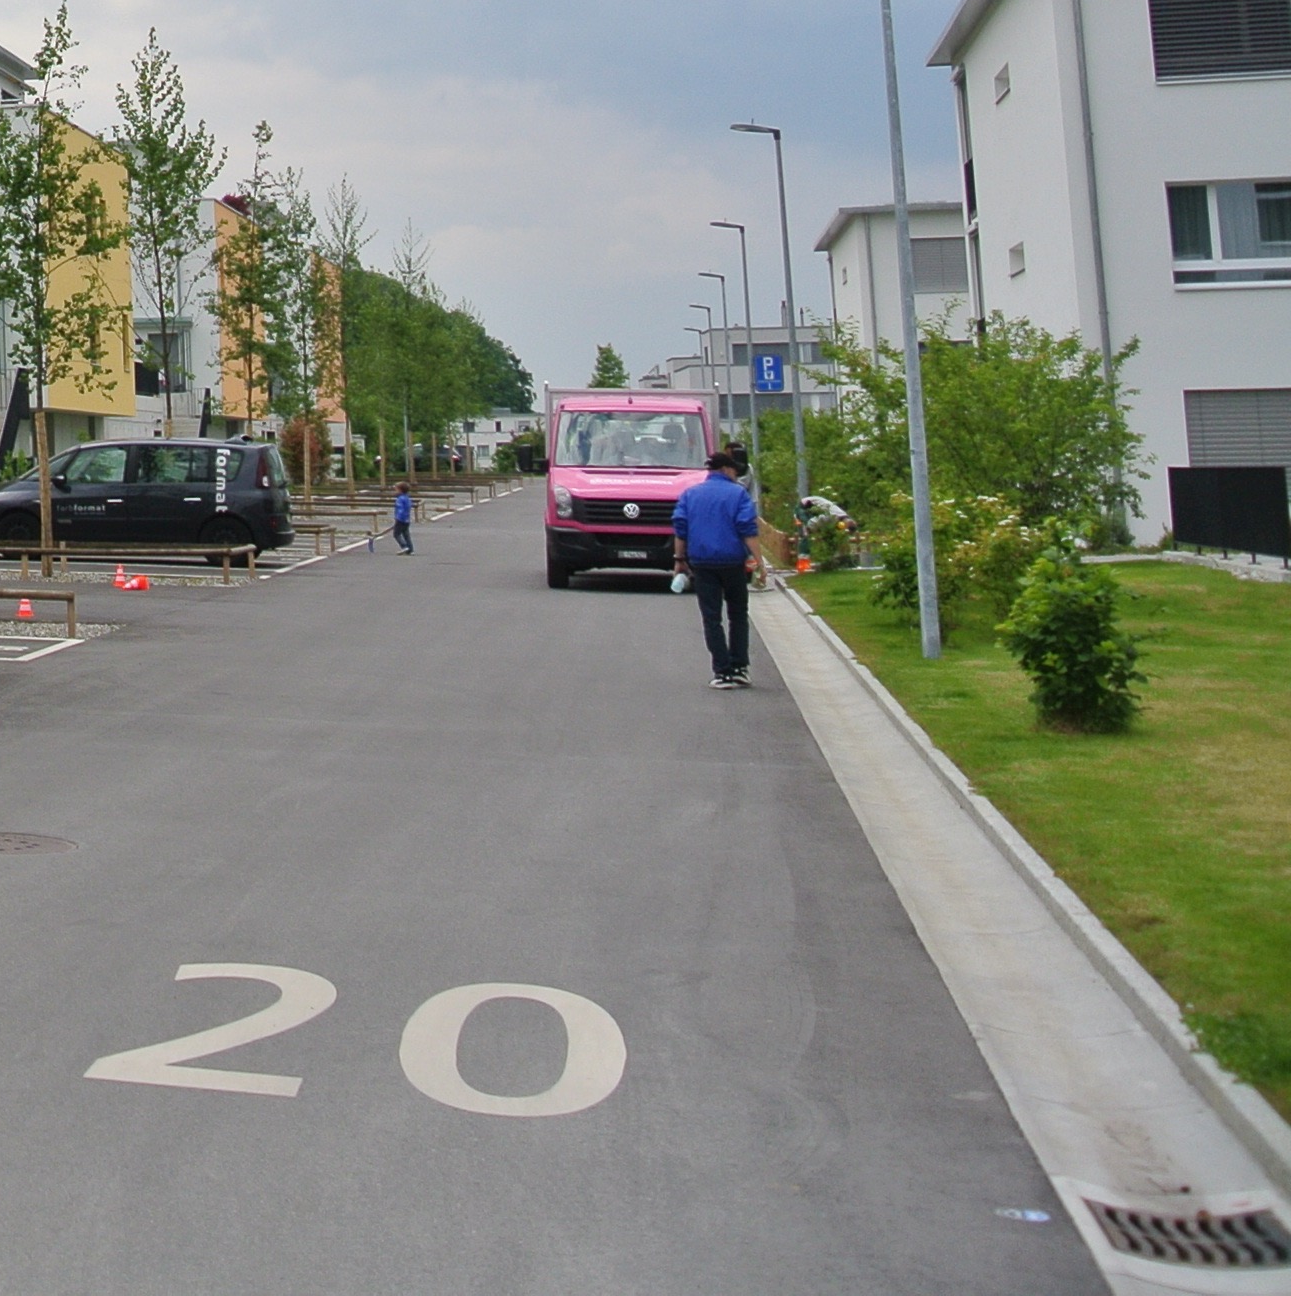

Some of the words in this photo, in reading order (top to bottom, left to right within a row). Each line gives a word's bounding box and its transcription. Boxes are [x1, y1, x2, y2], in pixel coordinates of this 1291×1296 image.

[763, 357, 773, 371] P
[216, 449, 230, 512] format
[83, 963, 626, 1117] 20
